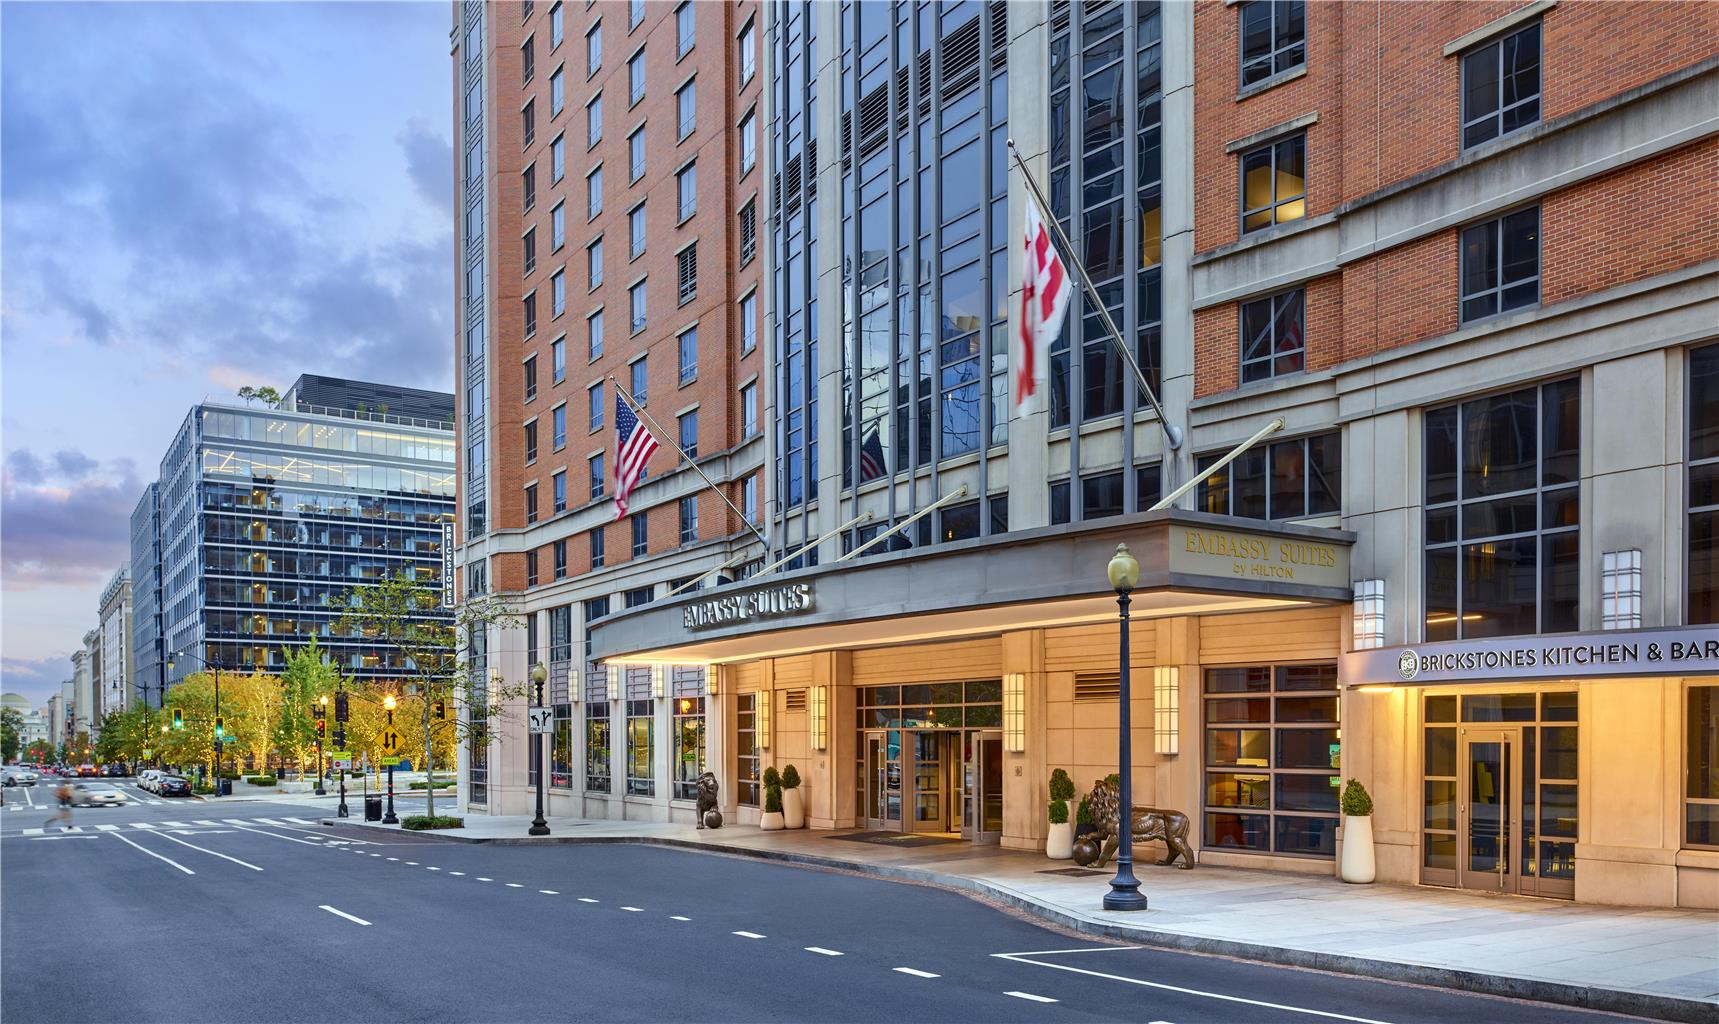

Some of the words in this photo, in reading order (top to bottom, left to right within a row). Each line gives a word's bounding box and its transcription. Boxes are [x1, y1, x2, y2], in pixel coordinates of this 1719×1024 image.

[1185, 531, 1270, 560] EMBASSY
[1280, 543, 1336, 567] SUITES
[1233, 562, 1246, 576] by
[1251, 564, 1293, 578] HILTON
[683, 596, 745, 628] EMBASSY
[748, 584, 809, 615] SUITES
[1421, 649, 1537, 671] BRICKSTONES
[1542, 643, 1638, 666] KITCHEN
[1648, 642, 1663, 661] &
[1671, 640, 1719, 660] BAR
